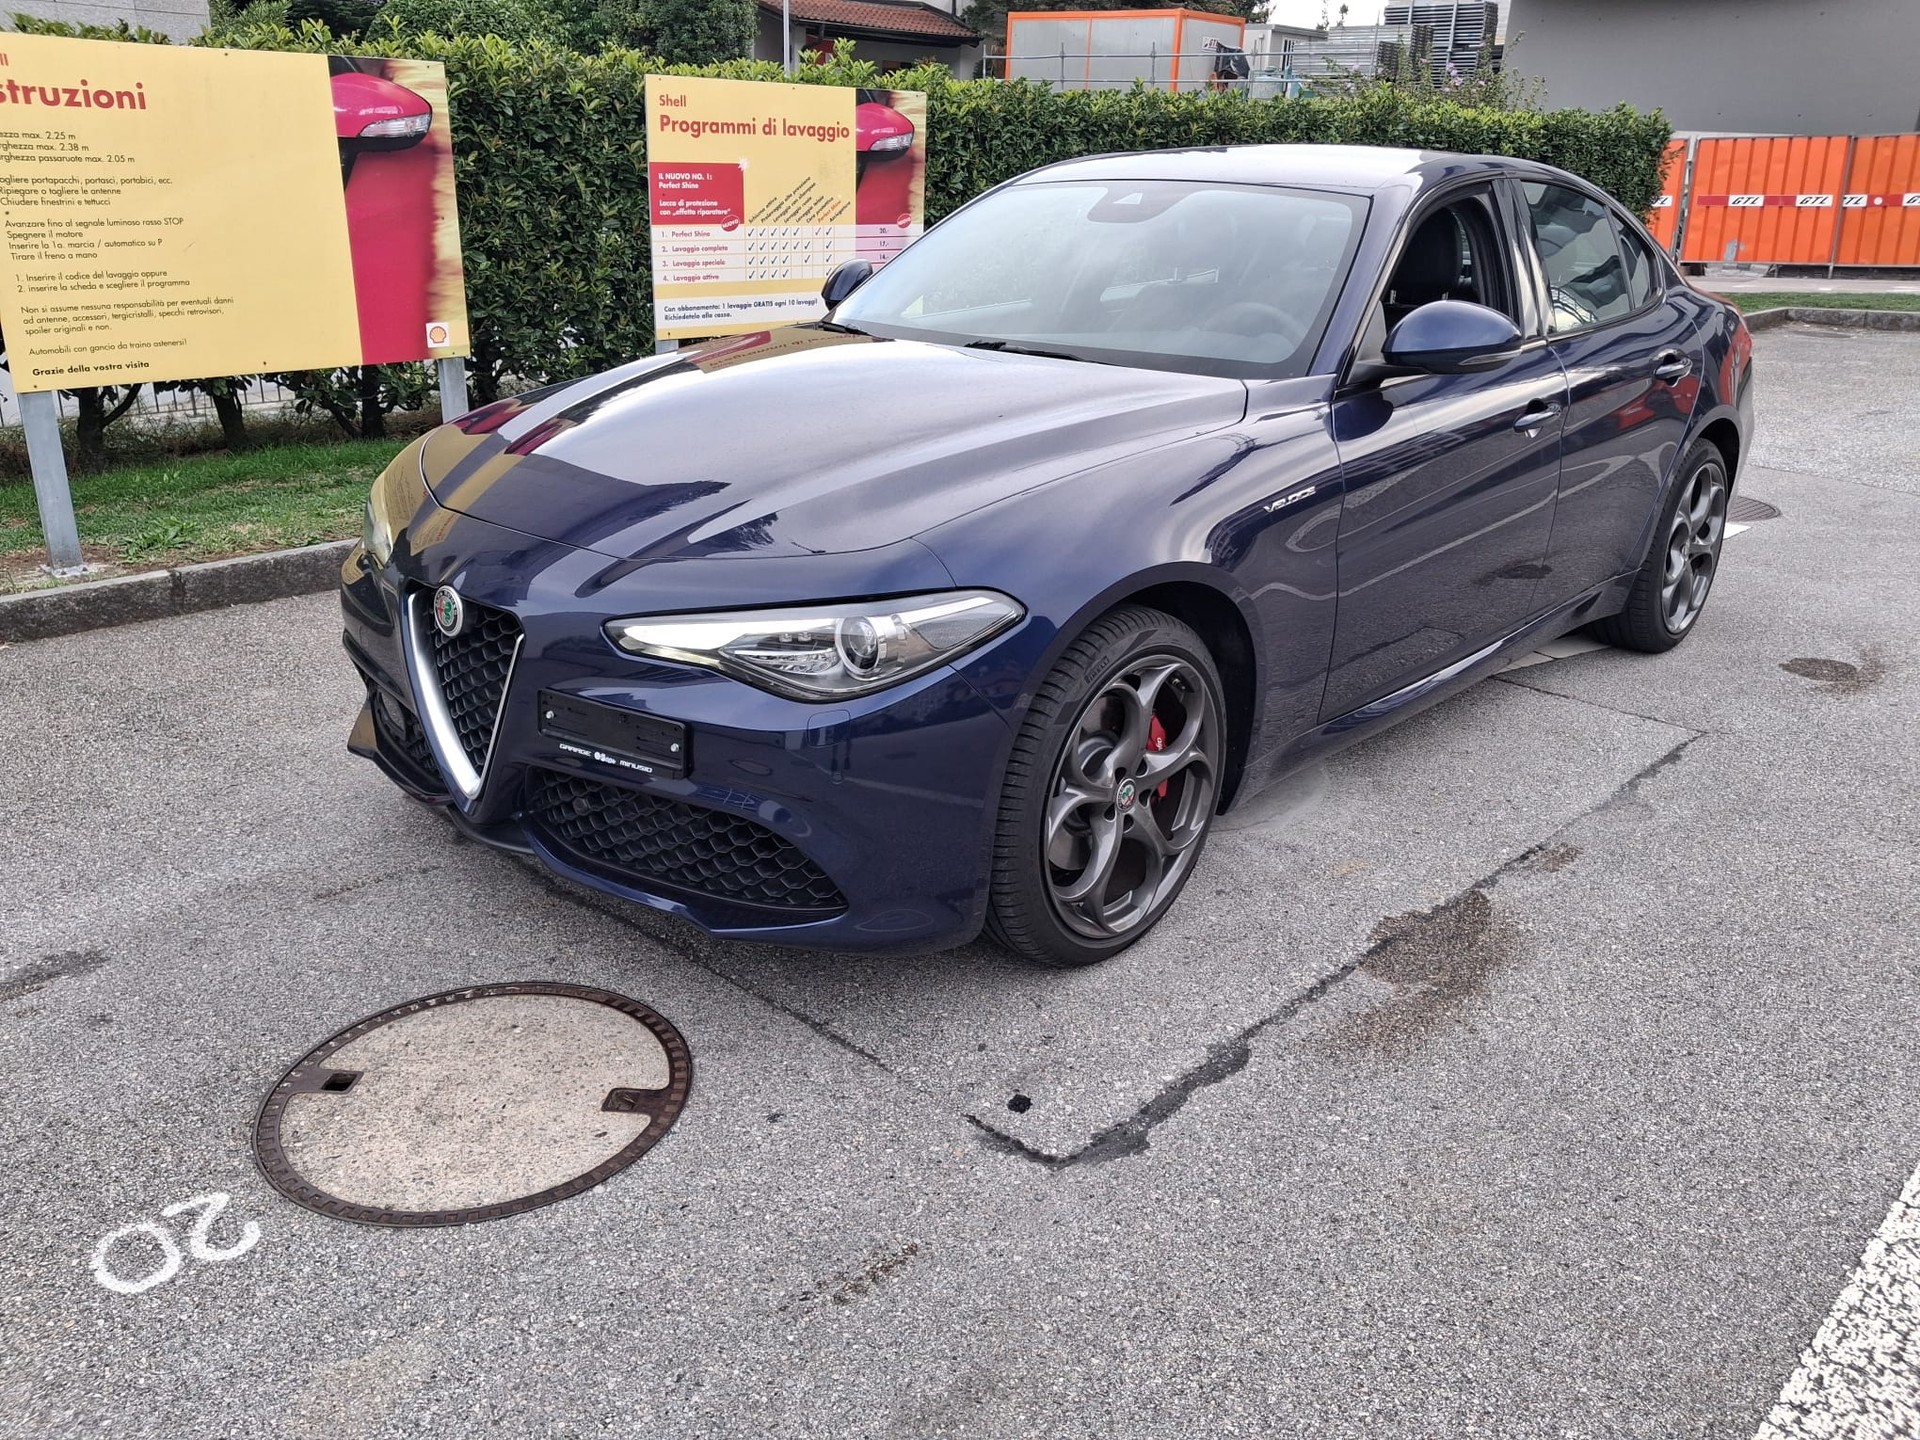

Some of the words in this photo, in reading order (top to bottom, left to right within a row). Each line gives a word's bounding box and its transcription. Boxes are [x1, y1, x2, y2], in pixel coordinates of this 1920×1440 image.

[659, 94, 686, 108] Shell
[660, 114, 756, 138] Programmi
[762, 118, 777, 136] di
[782, 121, 850, 142] lavaggio
[45, 131, 66, 140] 2.25
[59, 143, 79, 151] 2.38
[49, 186, 79, 197] togliere
[81, 186, 88, 194] le
[0, 197, 39, 206] Chiudere
[41, 197, 75, 206] finestrini
[1731, 197, 1759, 205] GTL
[1799, 196, 1827, 205] GTL
[1843, 196, 1864, 205] TL
[47, 219, 63, 227] fino
[65, 219, 73, 227] al
[75, 218, 105, 229] segnale
[7, 231, 46, 241] Spegnere
[672, 245, 700, 253] Lavaggio
[44, 251, 66, 259] freno
[16, 274, 24, 282] 1.
[26, 273, 56, 282] Inserire
[58, 273, 63, 281] il
[65, 272, 90, 280] codice
[92, 271, 104, 279] del
[106, 270, 139, 281] lavaggio
[140, 271, 167, 280] oppure
[59, 282, 68, 291] la
[70, 281, 97, 290] scheda
[106, 280, 139, 290] scegliere
[147, 280, 190, 289] programma
[114, 299, 164, 311] responsabilità
[166, 301, 179, 309] per
[727, 302, 752, 310] lavaggio
[774, 300, 786, 308] ogni
[23, 316, 34, 324] ad
[159, 309, 185, 318] specchi
[25, 326, 51, 336] spoiler
[29, 345, 71, 355] Automobili
[89, 343, 116, 353] gancio
[32, 367, 64, 376] Grazie
[67, 364, 90, 373] della
[1263, 486, 1316, 512] VELOCE
